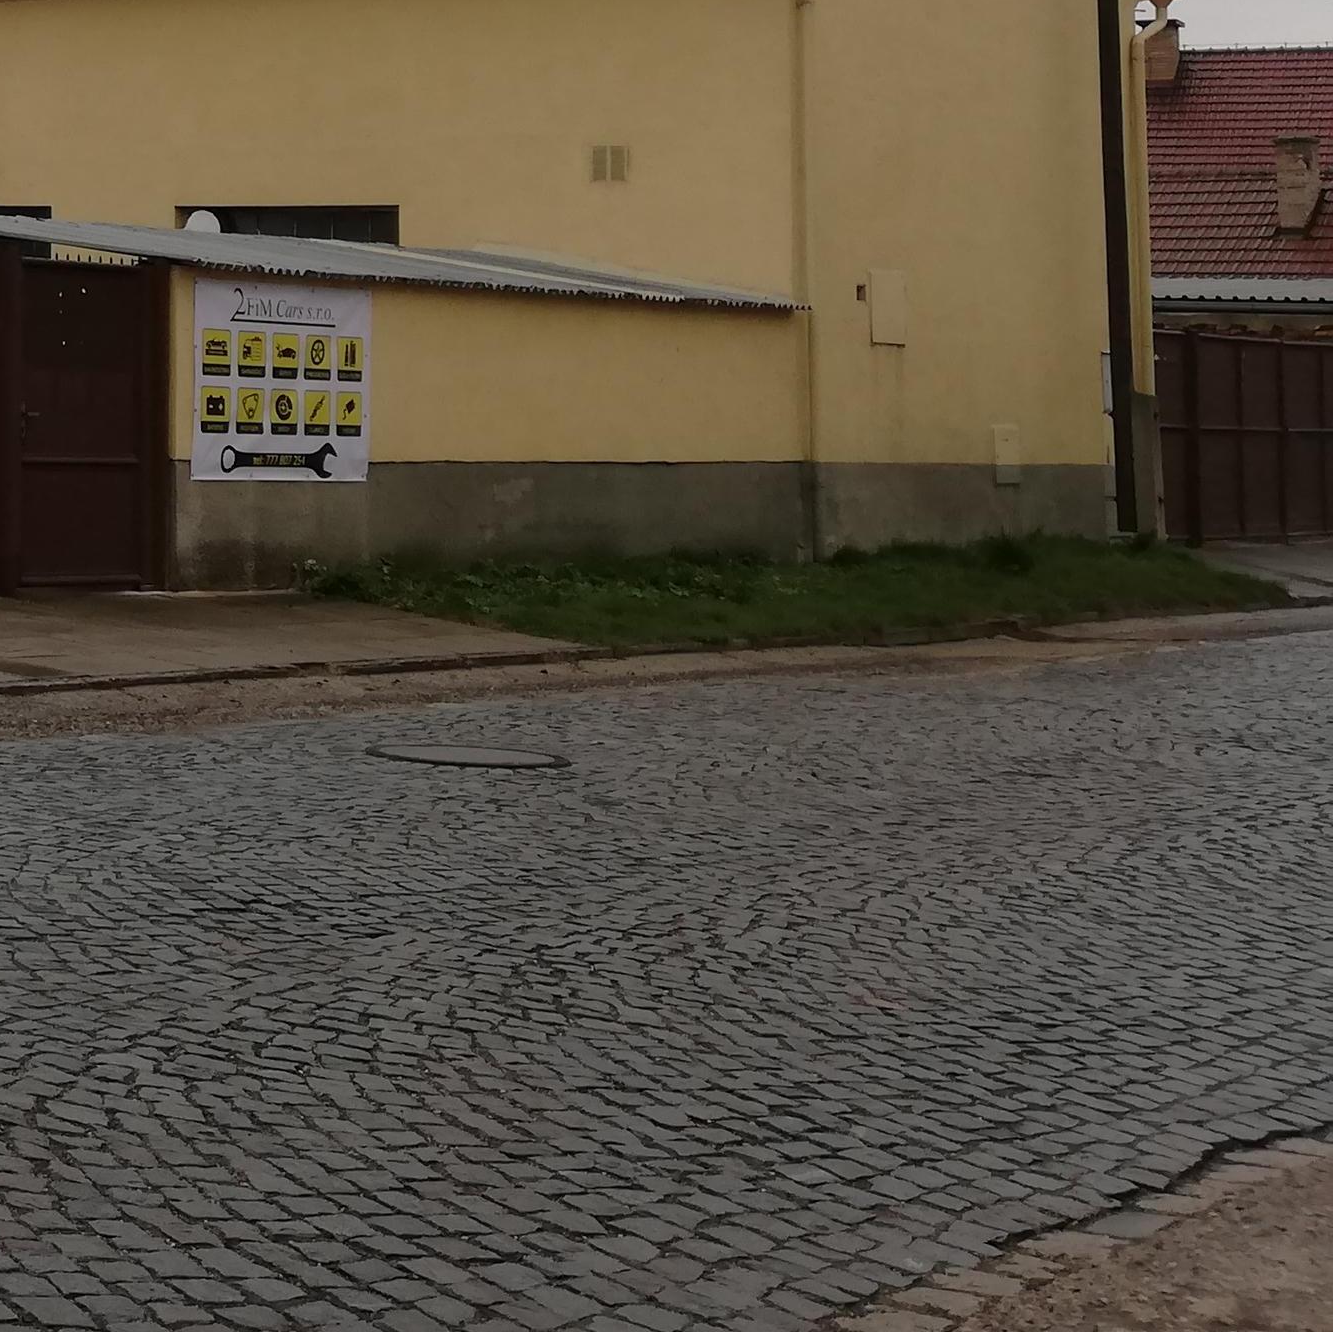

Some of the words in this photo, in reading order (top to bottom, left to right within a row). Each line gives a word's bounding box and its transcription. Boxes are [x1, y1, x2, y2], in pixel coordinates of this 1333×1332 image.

[276, 299, 304, 319] Cars
[306, 308, 335, 321] s.r.o.
[265, 455, 279, 466] 777
